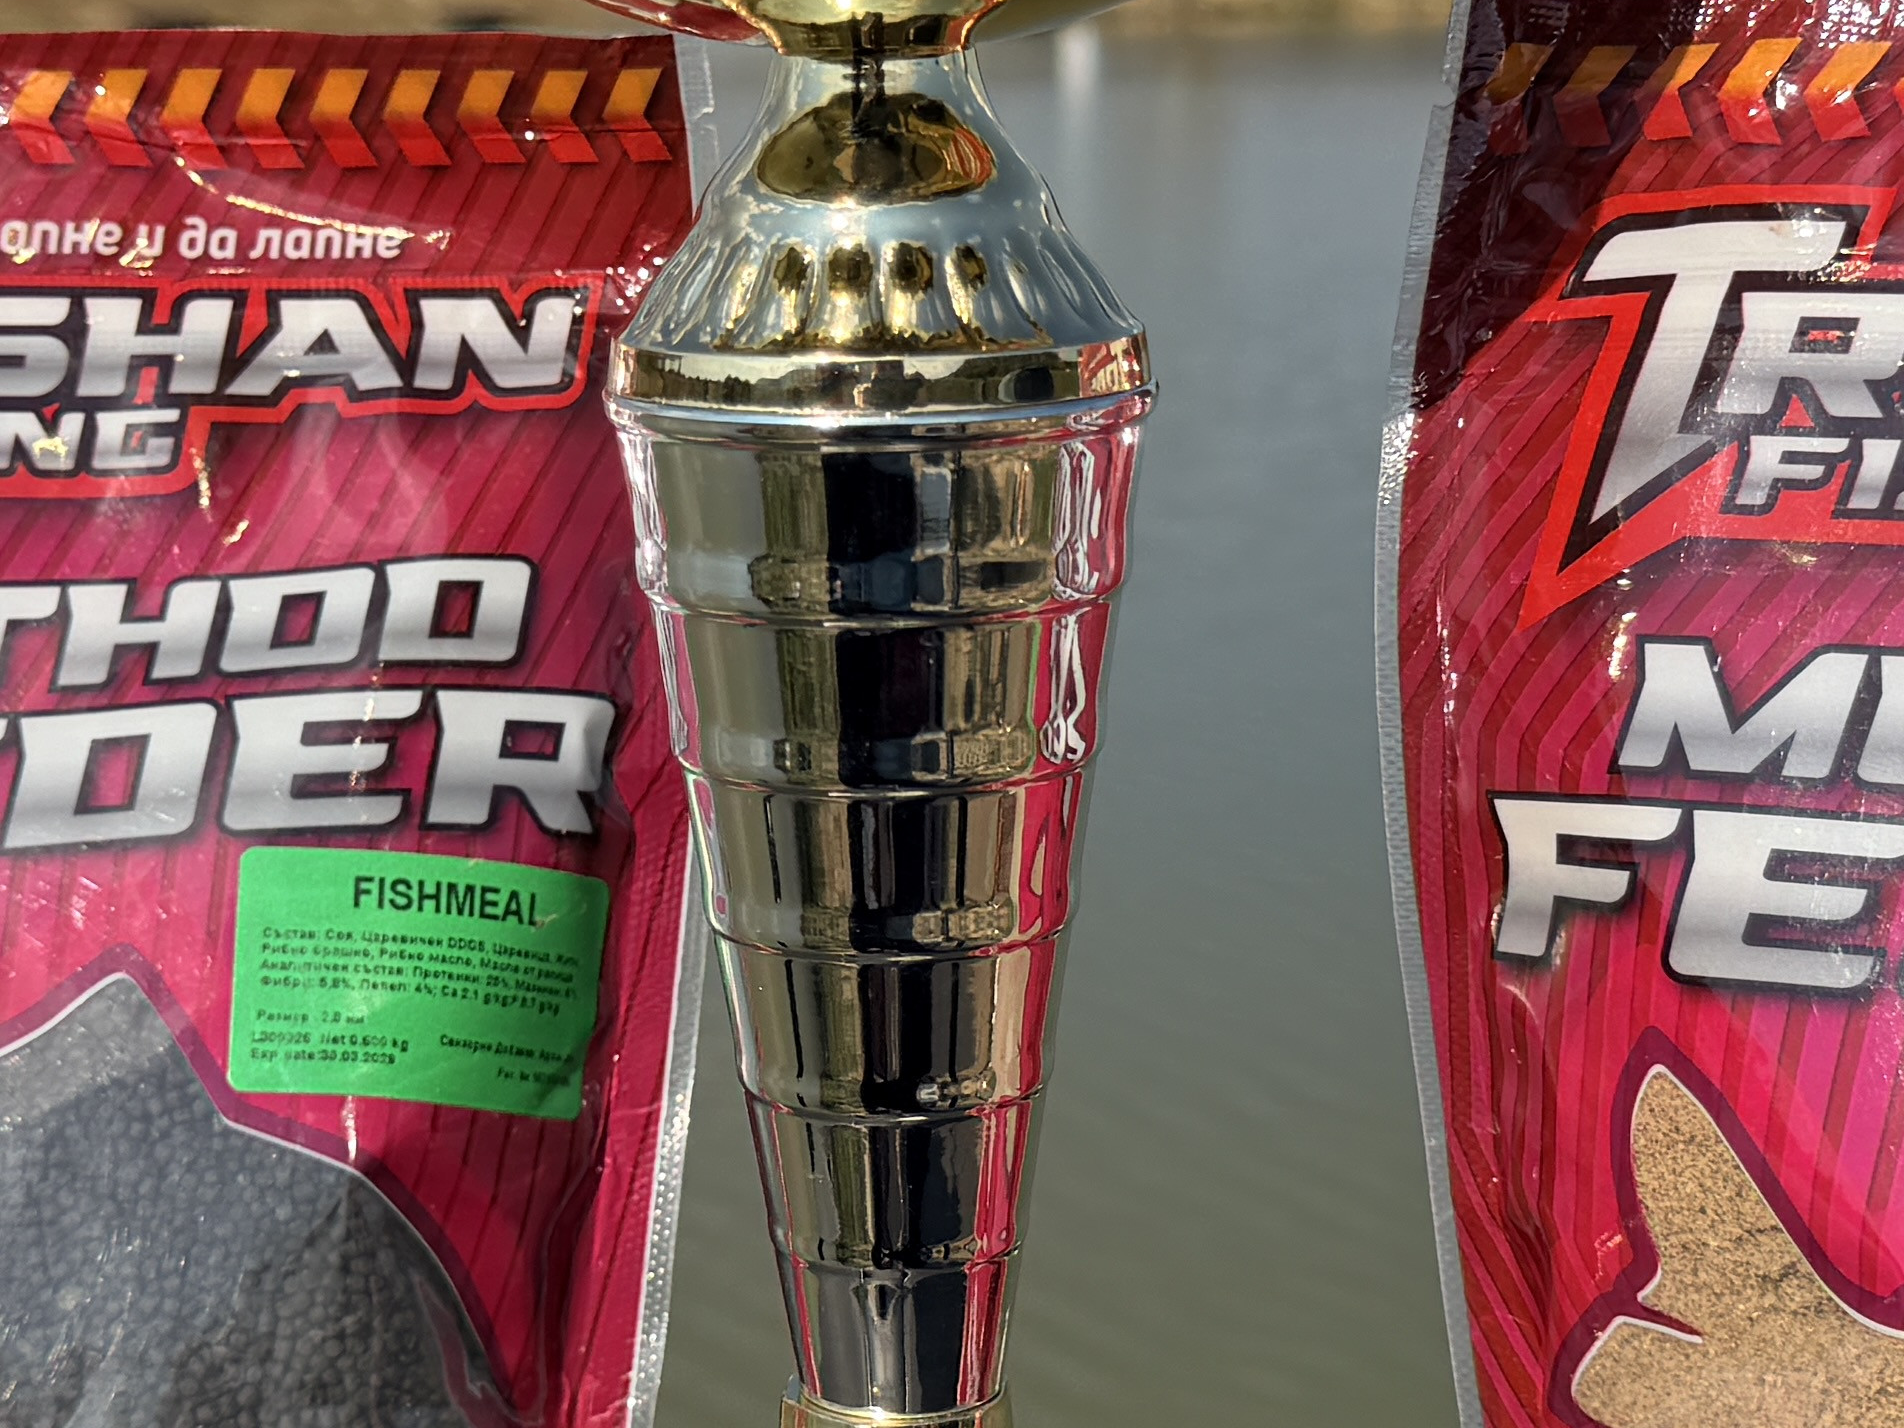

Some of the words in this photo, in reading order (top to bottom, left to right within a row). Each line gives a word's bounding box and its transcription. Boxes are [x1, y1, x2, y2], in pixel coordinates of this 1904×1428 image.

[184, 219, 237, 262] да
[248, 226, 403, 262] лапне
[353, 875, 540, 927] FISHMEAL
